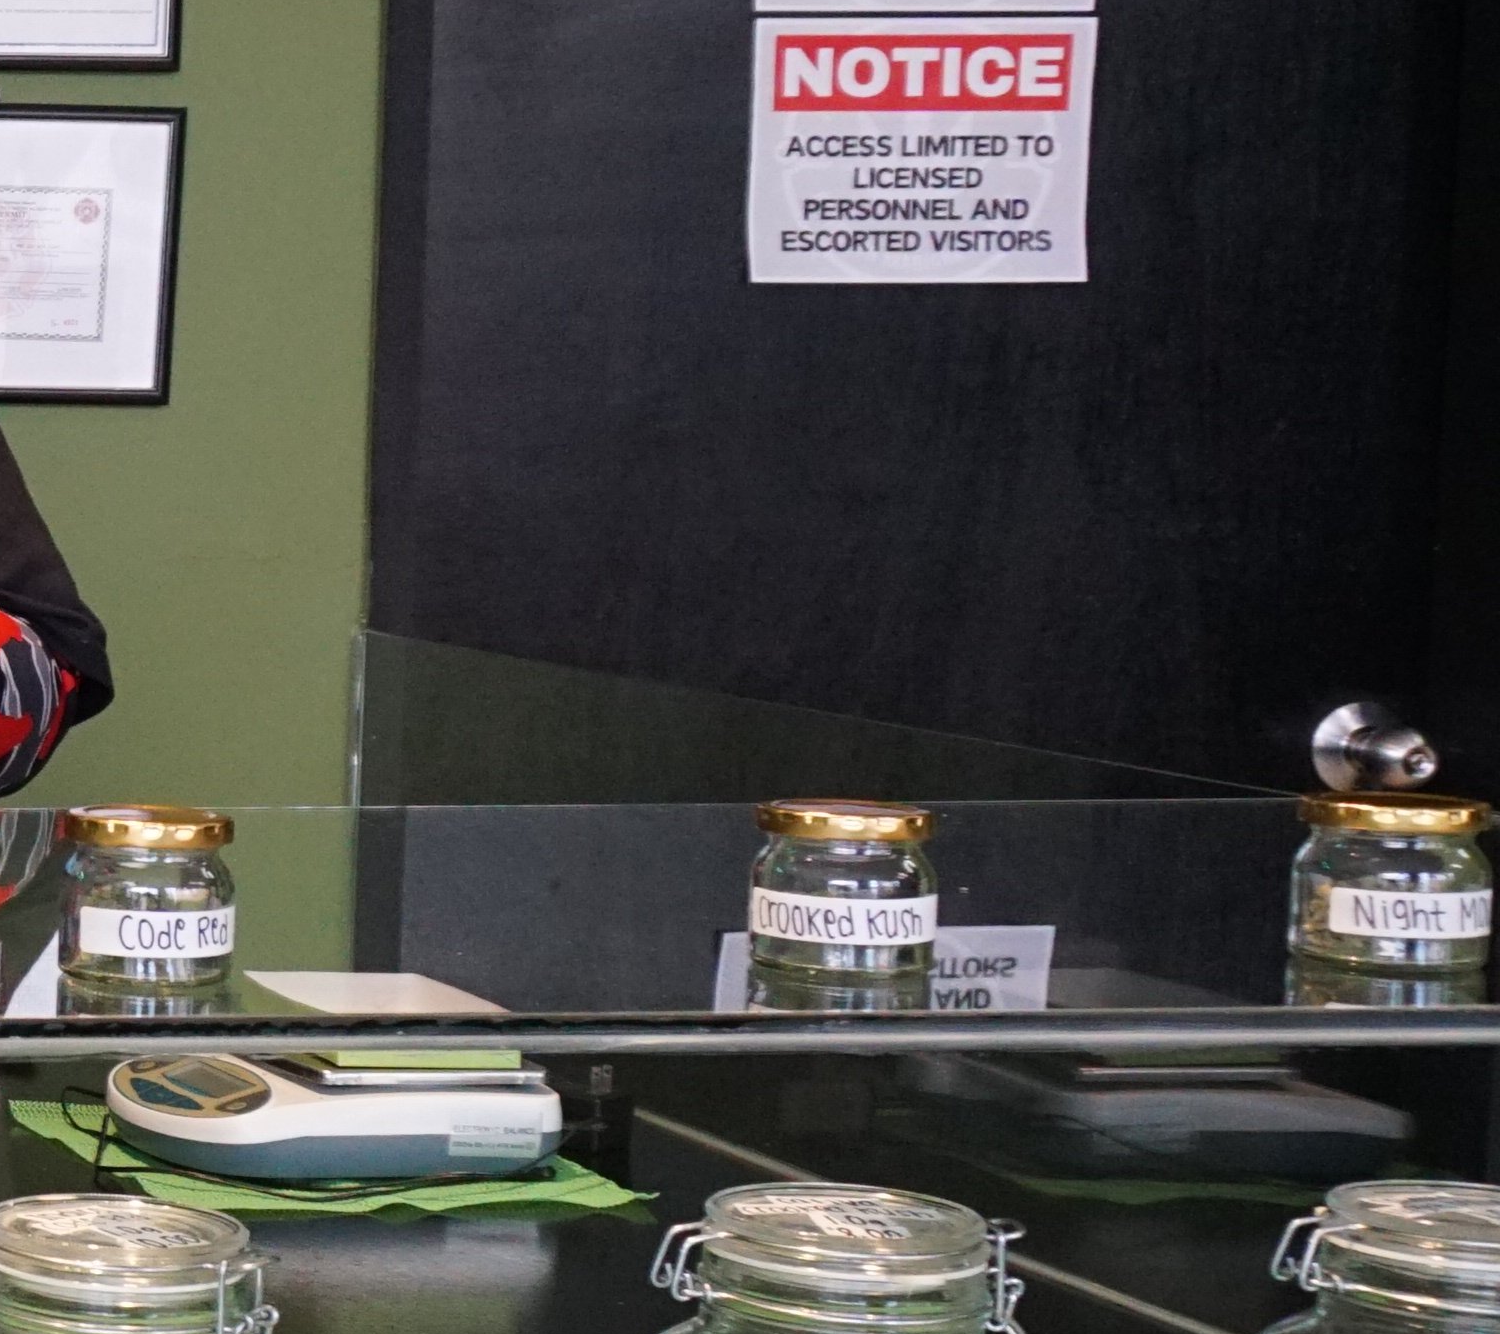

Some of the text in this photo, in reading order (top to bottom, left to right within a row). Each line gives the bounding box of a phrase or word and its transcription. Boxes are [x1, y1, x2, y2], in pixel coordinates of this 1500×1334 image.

[782, 46, 1065, 98] NOTICE
[785, 135, 1054, 158] ACCESS LIMITED TO
[853, 167, 983, 190] LICENSED
[803, 199, 1030, 222] PERSONNEL AND
[780, 230, 1052, 253] ESCORTED VISITORS
[1352, 894, 1447, 931] Night
[197, 914, 228, 949] Red
